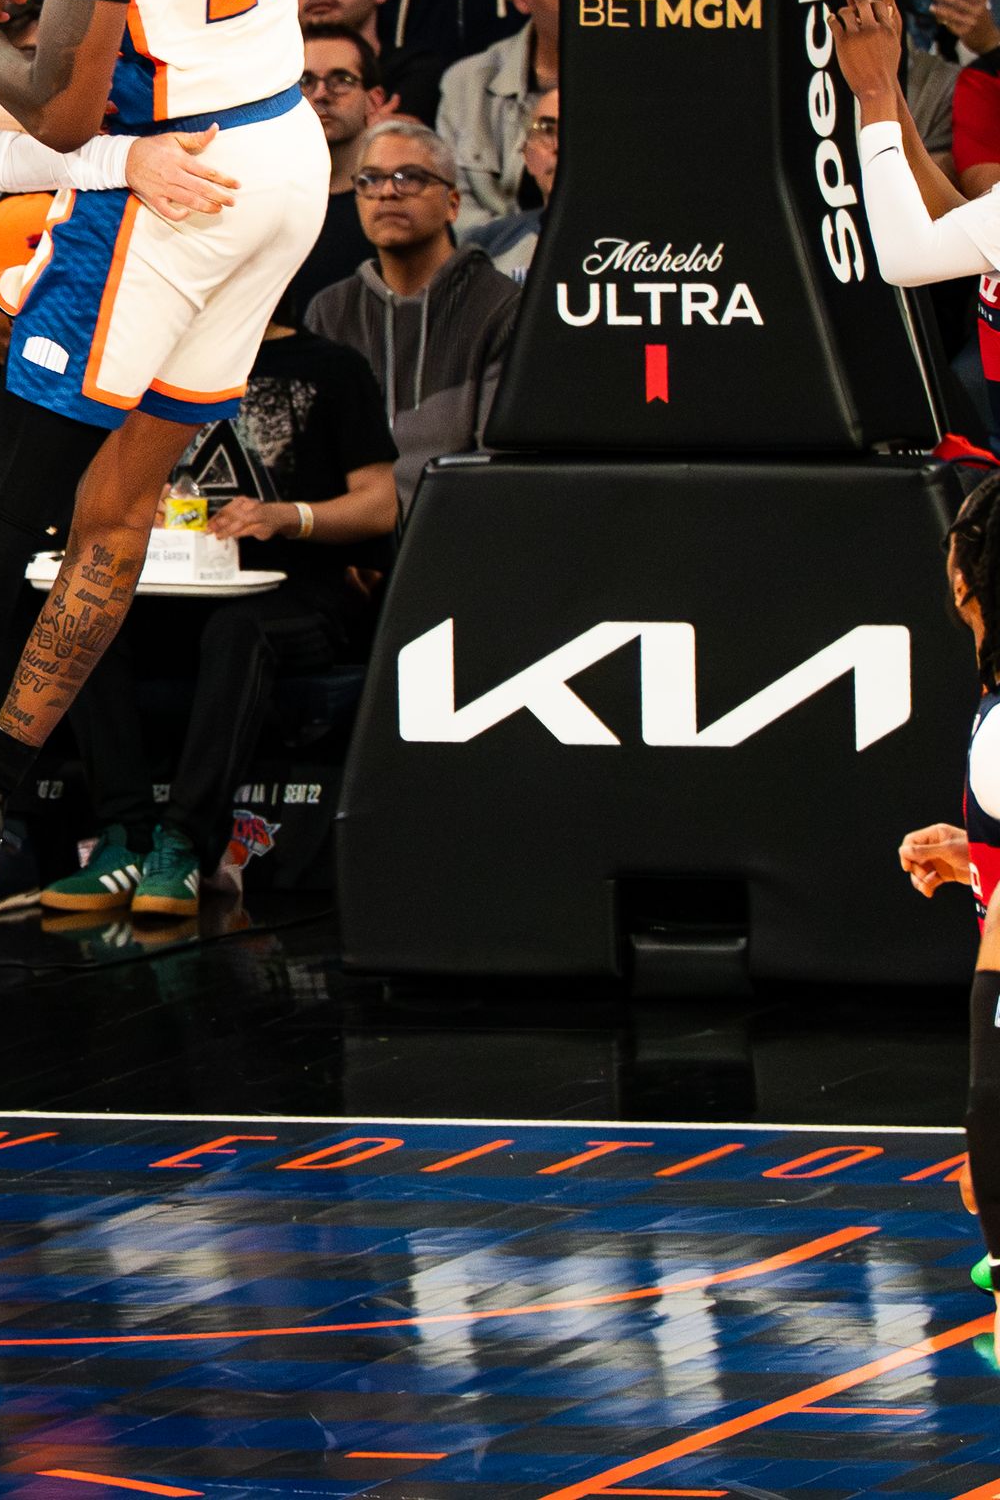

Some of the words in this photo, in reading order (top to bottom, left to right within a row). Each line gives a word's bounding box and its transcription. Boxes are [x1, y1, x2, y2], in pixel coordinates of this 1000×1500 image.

[582, 237, 724, 276] Michelob
[556, 283, 764, 327] ULTRA
[397, 617, 911, 752] KIA
